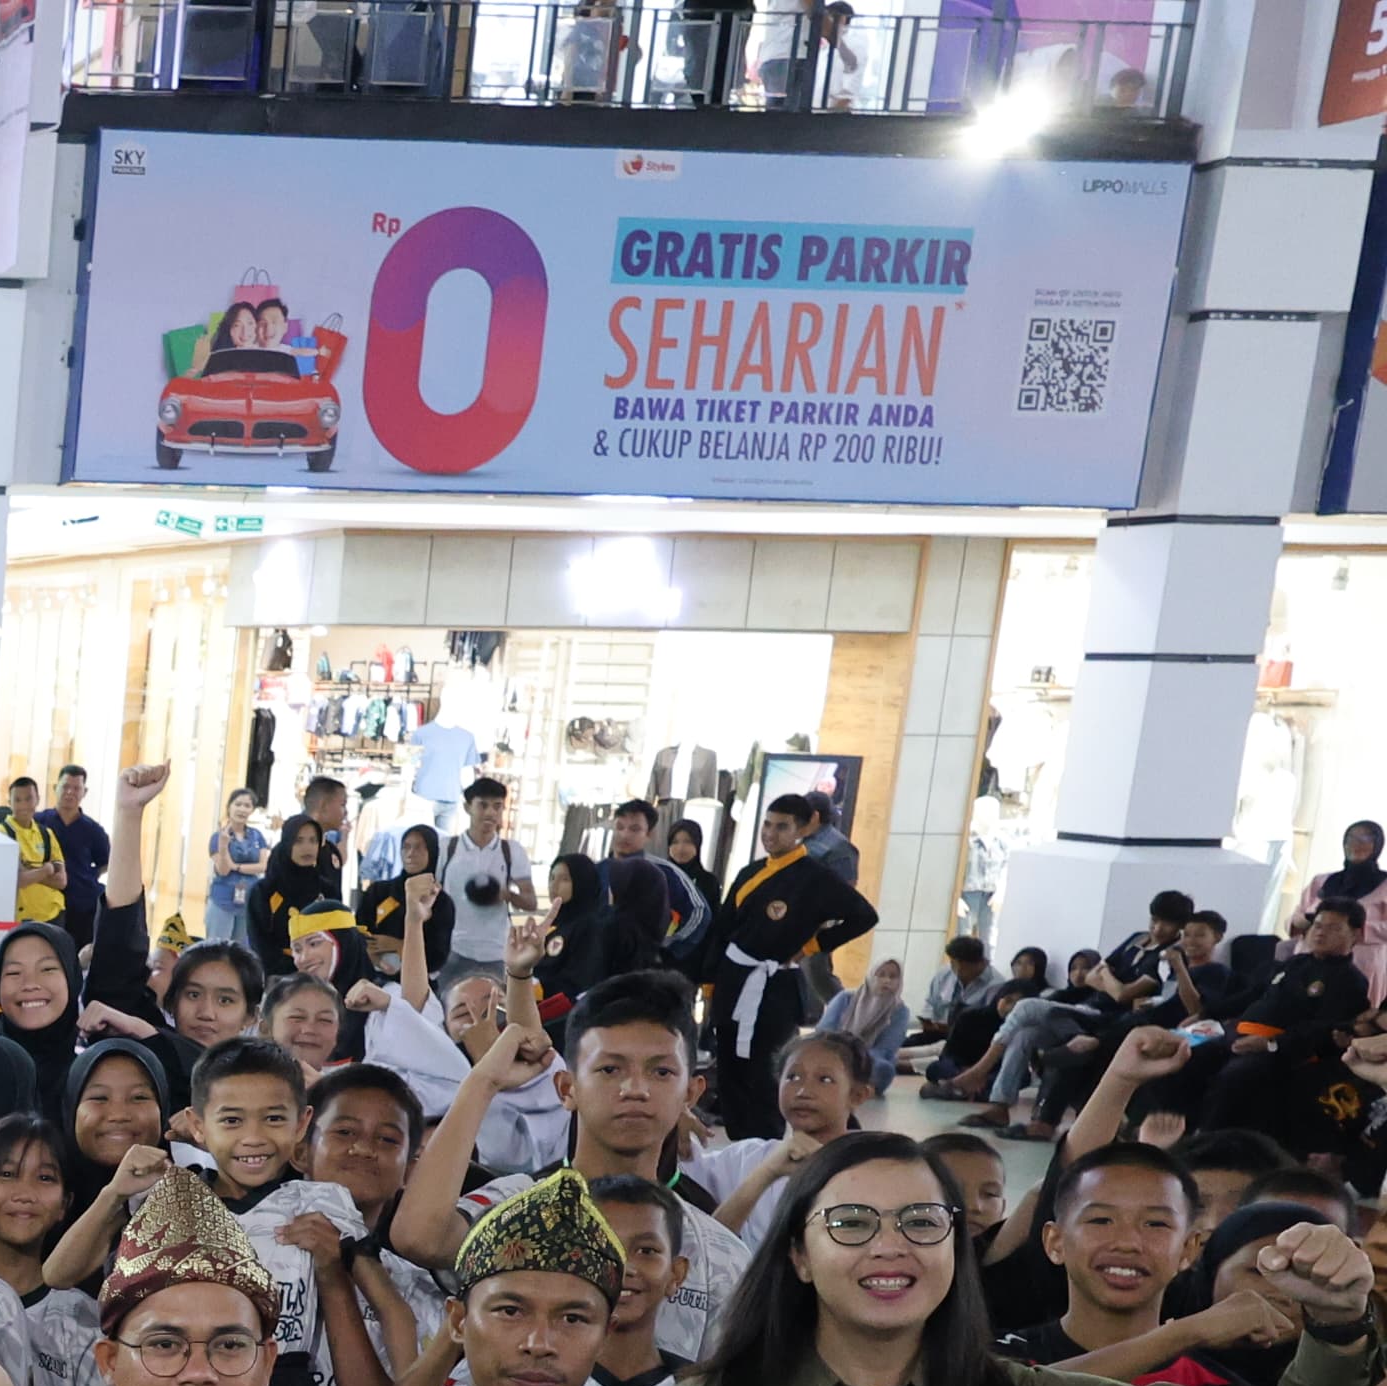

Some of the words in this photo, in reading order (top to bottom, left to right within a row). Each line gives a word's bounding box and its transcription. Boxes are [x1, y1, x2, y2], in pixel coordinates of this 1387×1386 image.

[114, 149, 145, 165] SKY
[372, 212, 401, 237] Rp
[620, 228, 783, 281] GRATIS
[796, 234, 972, 286] PARKIR
[362, 205, 550, 475] 0
[603, 295, 946, 397] SEHARIAN
[613, 396, 685, 422] BAWA
[695, 398, 762, 424] TIKET
[768, 400, 860, 427] PARKIR
[868, 403, 935, 429] ANDA
[593, 429, 609, 457] &
[618, 428, 692, 460] CUKUP
[698, 431, 791, 462] BELANJA
[798, 434, 827, 462] RP
[833, 434, 875, 465] 200
[882, 435, 944, 466] RIBU!
